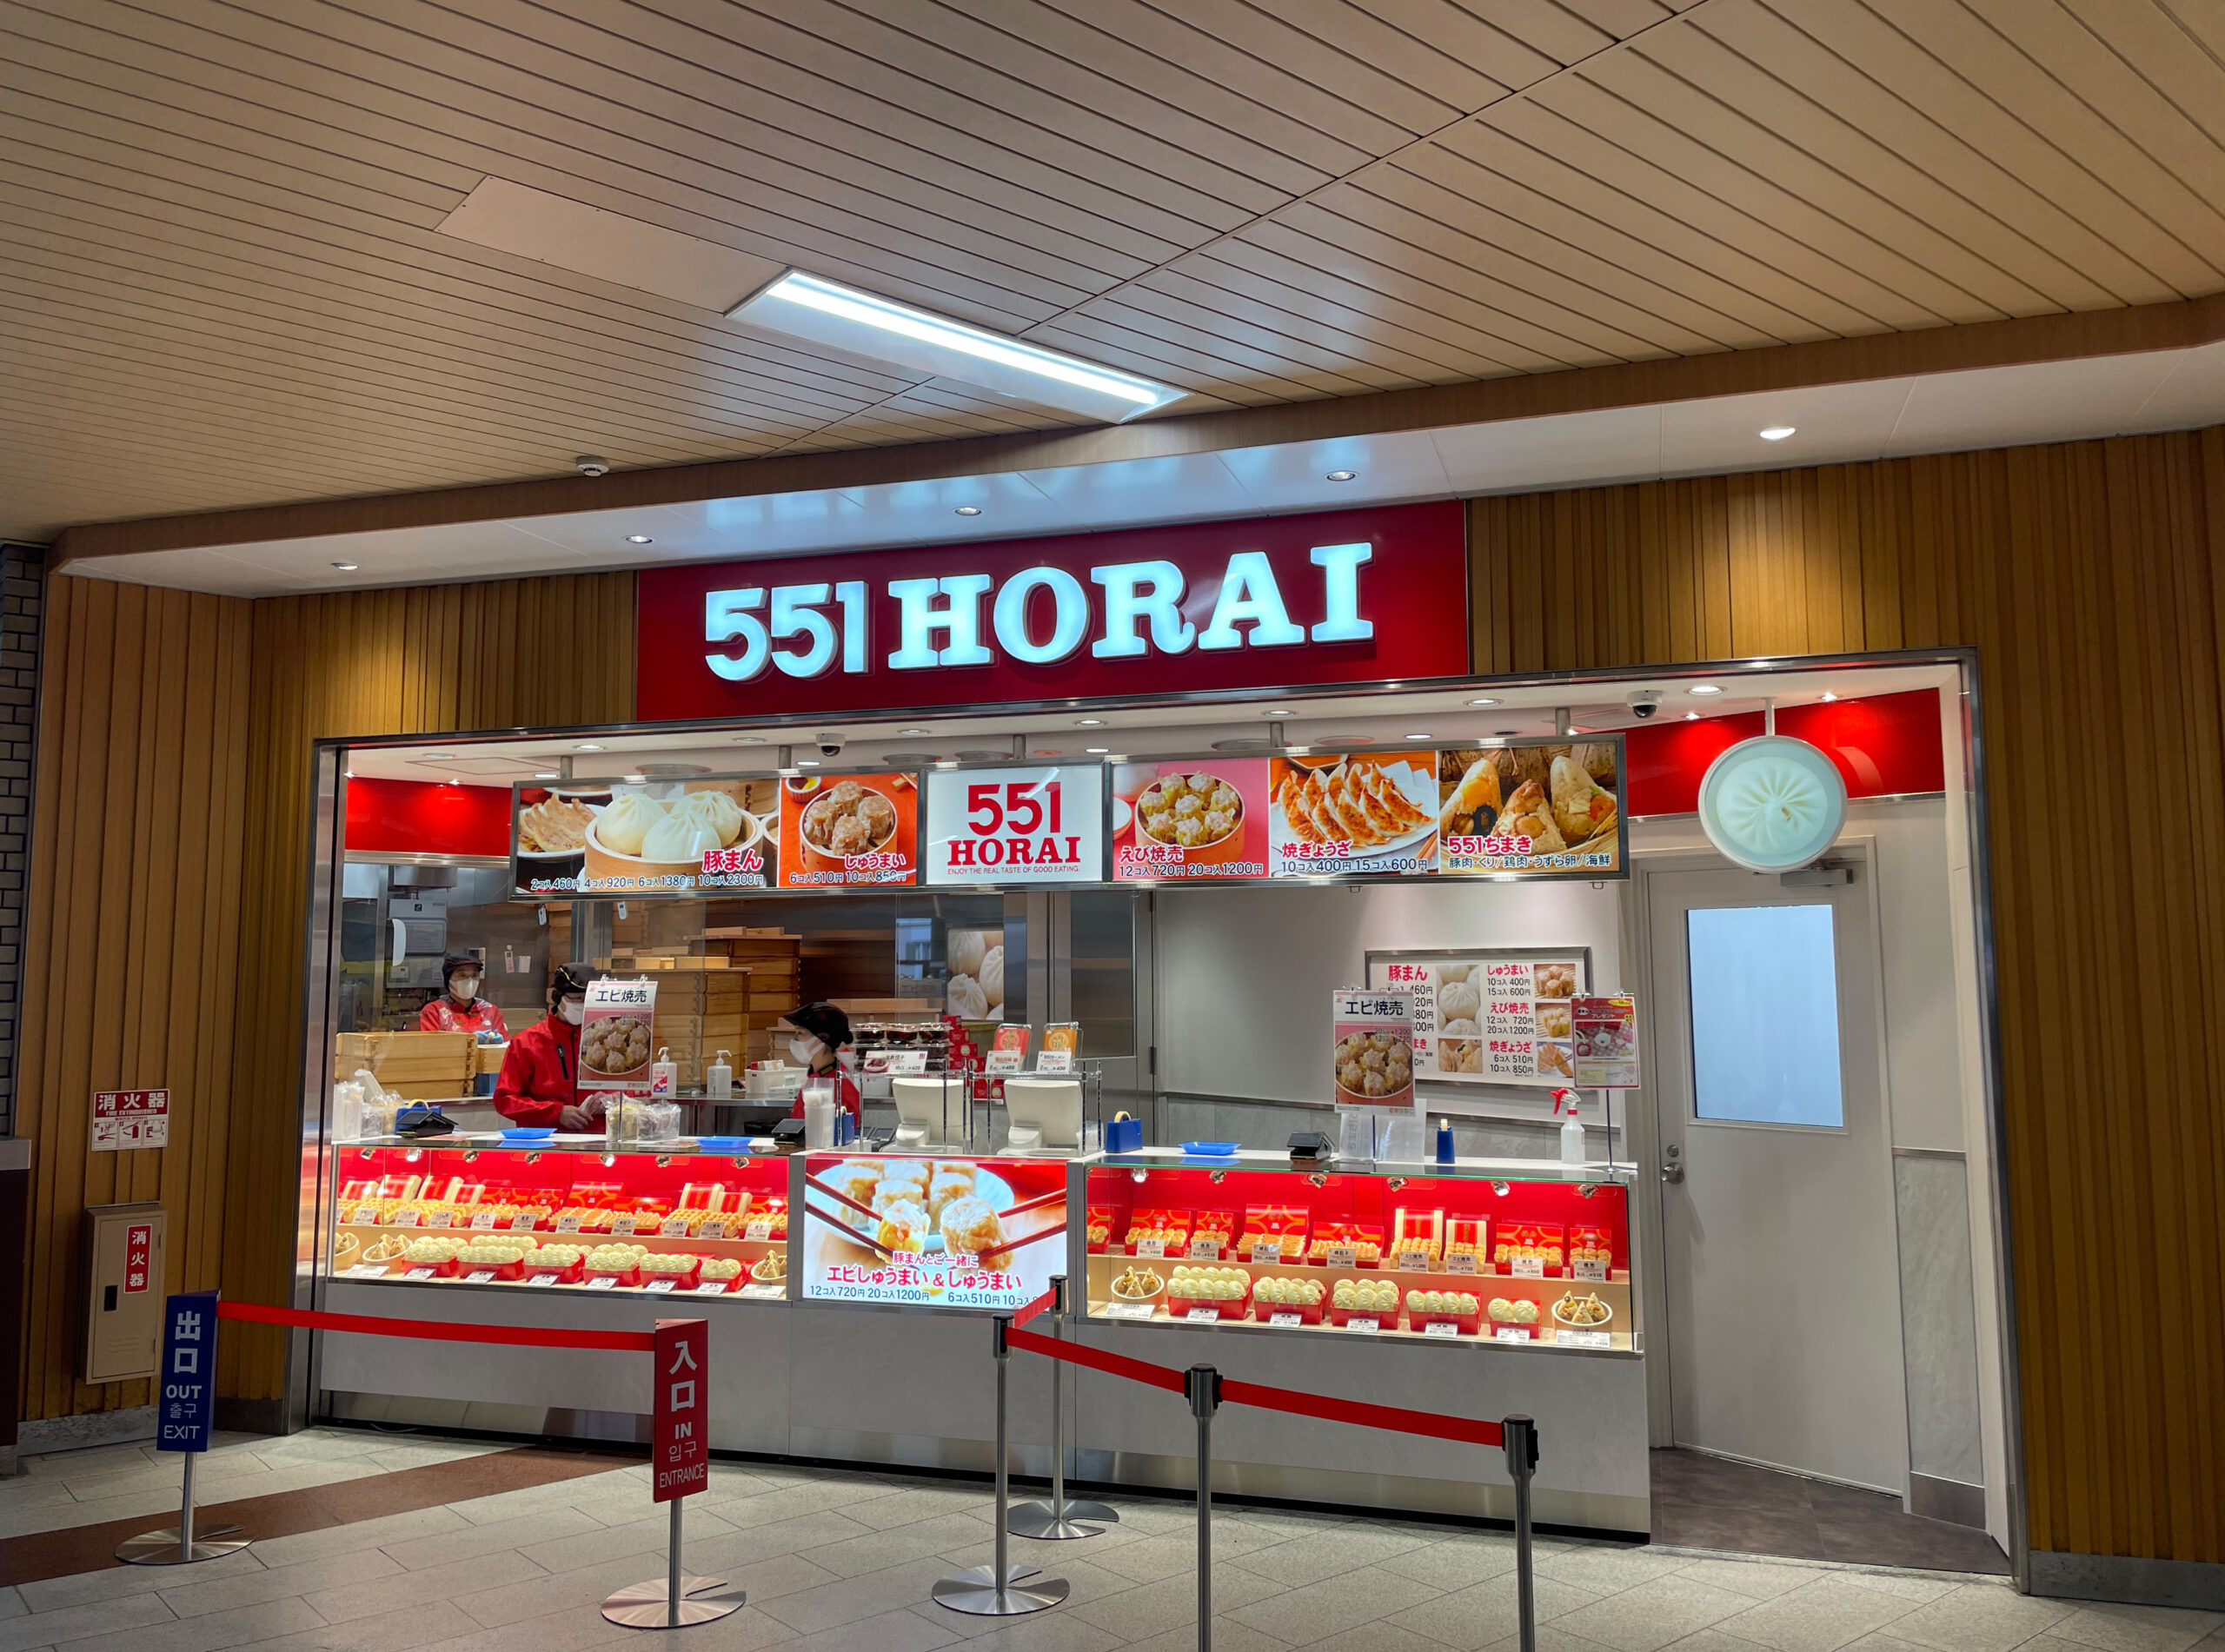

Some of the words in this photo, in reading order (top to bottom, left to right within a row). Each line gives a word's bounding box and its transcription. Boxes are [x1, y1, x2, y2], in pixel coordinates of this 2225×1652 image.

[706, 581, 867, 680] 551
[887, 541, 1375, 670] HORAI
[968, 781, 1060, 836] 551
[947, 837, 1080, 866] HORAI
[1282, 840, 1352, 859] 焼ぎょうざ
[1448, 836, 1532, 854] 551ちまき
[702, 849, 764, 872] 豚まん
[845, 853, 907, 869] しゅうまい
[1119, 845, 1184, 863] えび焼売
[1119, 864, 1185, 877] 12コ入720円
[1187, 863, 1263, 876] 20コ入1200円
[1281, 859, 1352, 872] 10コ入400円
[1355, 858, 1428, 872] 15コ入600円
[584, 877, 634, 889] 4コ入920円
[698, 873, 764, 886] 10コ入2300円
[790, 871, 844, 884] 6コ入510円
[1388, 965, 1428, 981] 豚まん
[1487, 964, 1529, 976] しゅうまい
[595, 990, 648, 1003] エビ焼売
[1510, 987, 1531, 996] 600円
[1345, 999, 1404, 1016] エビ焼売
[1490, 1002, 1530, 1014] えび焼売
[1513, 1016, 1534, 1025] 720円
[1489, 1040, 1532, 1053] 焼ぎょうざ
[1512, 1055, 1533, 1064] 510円
[1512, 1065, 1533, 1074] 850円
[98, 1092, 165, 1111] 消火器
[130, 1231, 147, 1288] 消火器
[893, 1251, 979, 1268] 豚まんとご一緒に
[827, 1264, 929, 1285] エビしゅうまい
[933, 1275, 943, 1286] &
[948, 1269, 1021, 1290] しゅうまい
[810, 1285, 865, 1298] 12コ入720円
[867, 1288, 930, 1301] 20コ入1200円
[948, 1291, 1000, 1305] 6コ入510円
[174, 1310, 202, 1374] 出口
[668, 1340, 698, 1412] 入口
[166, 1384, 202, 1399] OUT
[169, 1403, 197, 1420] 출구
[163, 1424, 201, 1440] EXIT
[674, 1422, 692, 1440] IN
[668, 1441, 697, 1463] 입구
[659, 1463, 705, 1489] ENTRANCE
